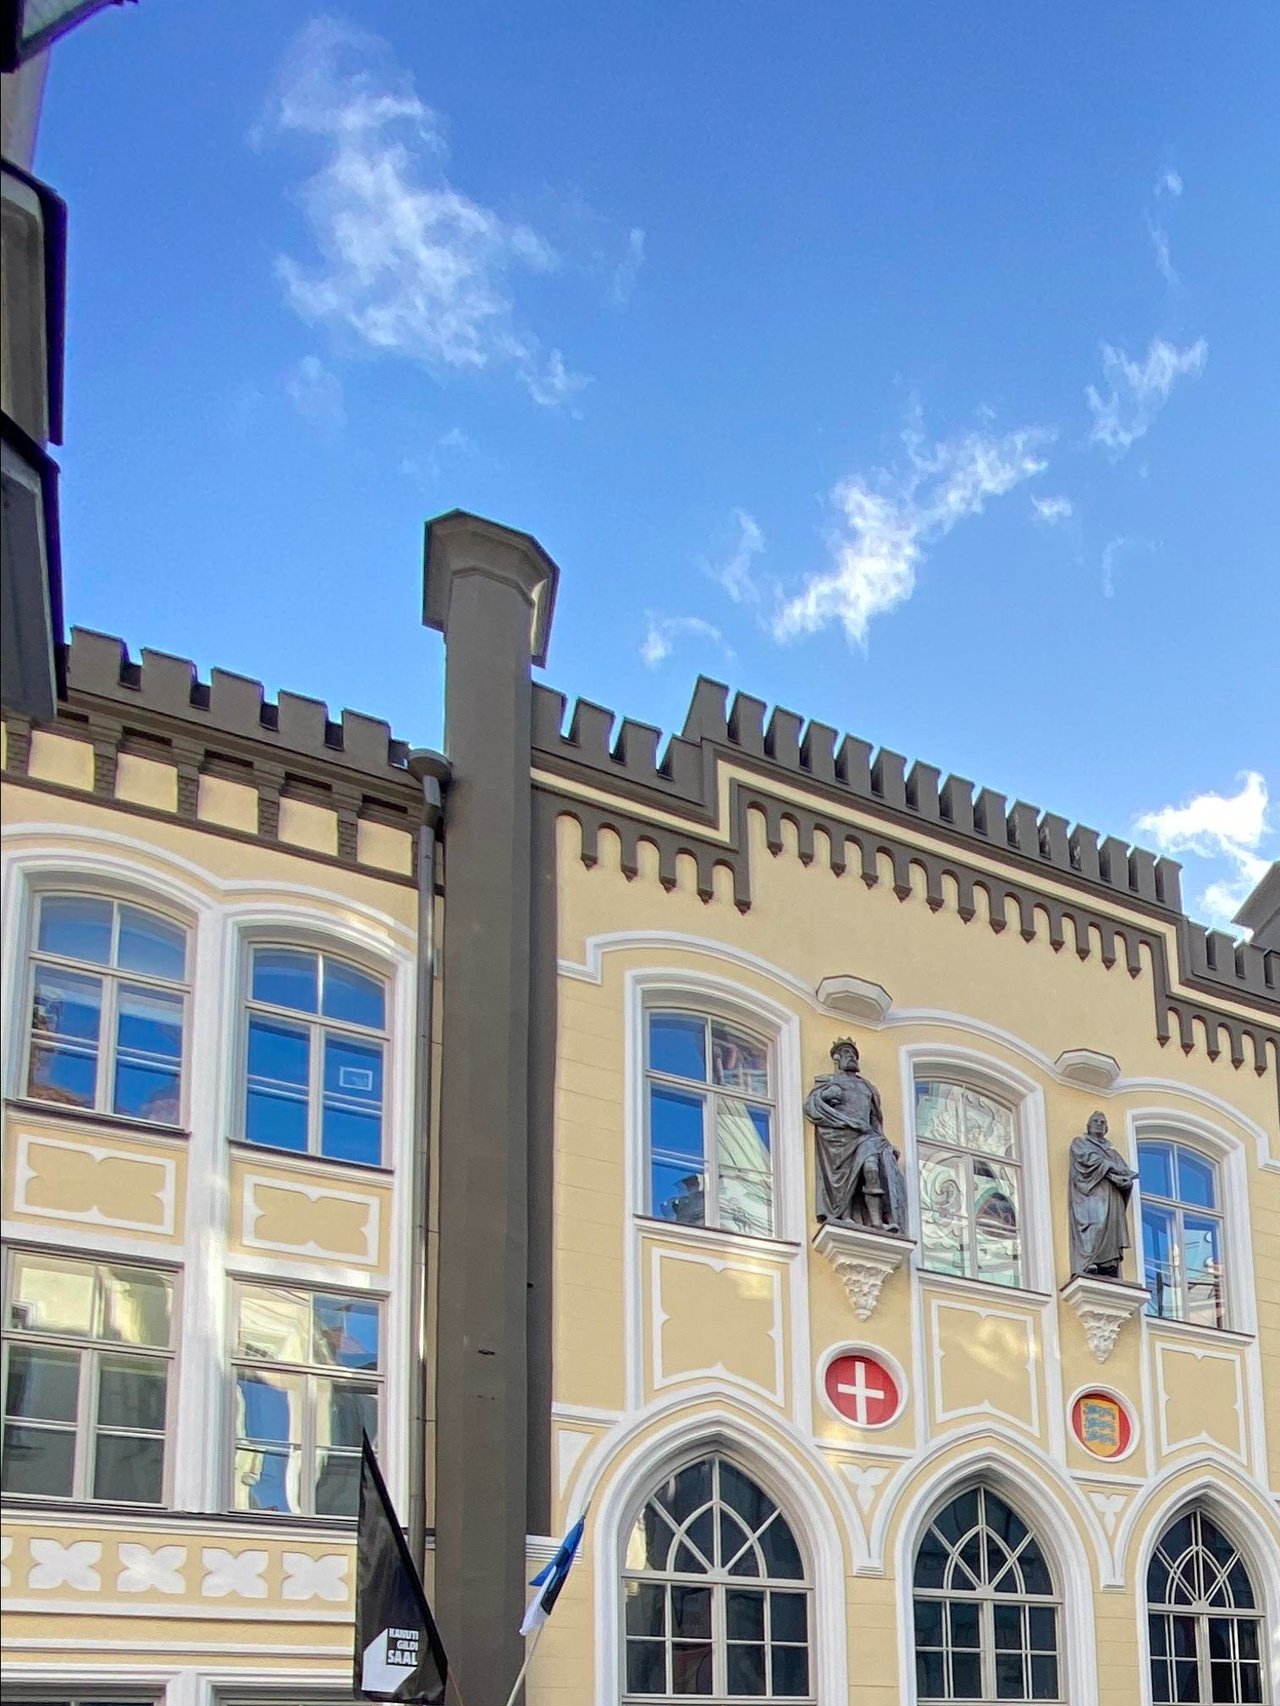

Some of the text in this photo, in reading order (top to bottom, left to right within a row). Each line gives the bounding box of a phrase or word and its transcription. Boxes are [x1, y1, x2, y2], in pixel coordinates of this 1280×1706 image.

[389, 1628, 419, 1640] KANUTI
[396, 1640, 419, 1651] GILDI
[387, 1650, 418, 1665] SAAL
